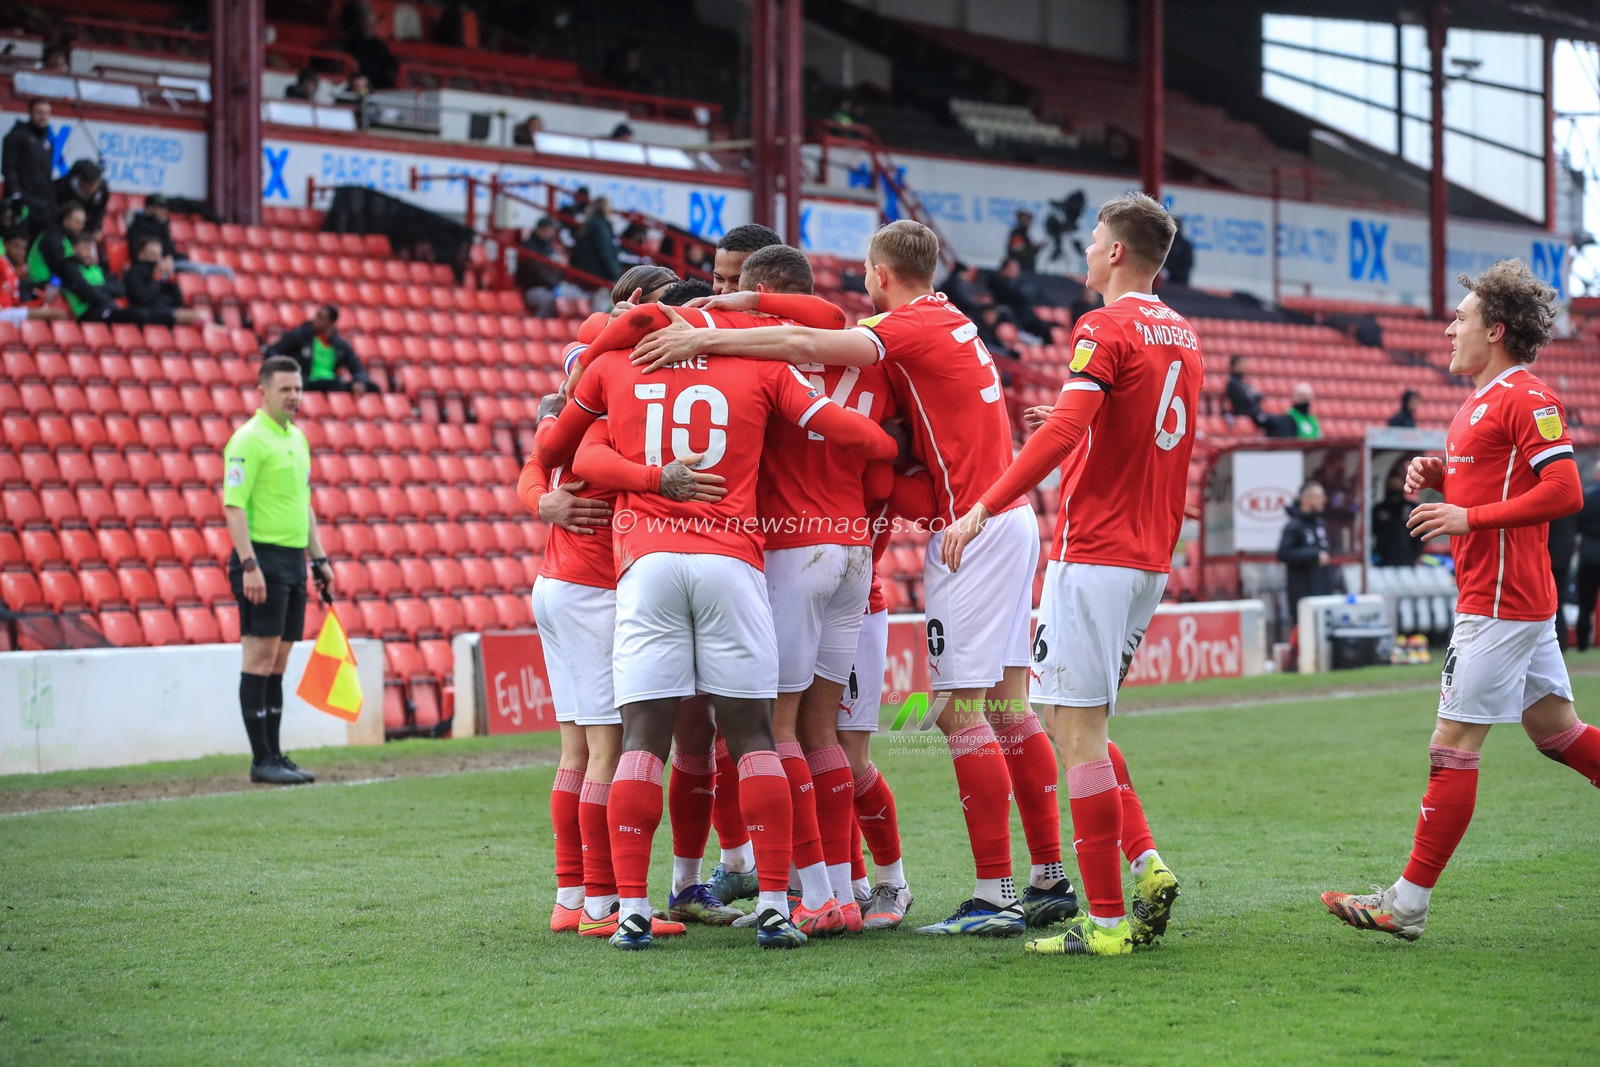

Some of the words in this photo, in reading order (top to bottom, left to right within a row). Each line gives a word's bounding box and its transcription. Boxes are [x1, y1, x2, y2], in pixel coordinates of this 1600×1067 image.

[98, 132, 183, 163] DELIVERED
[322, 153, 406, 191] PARCEL
[689, 191, 726, 237] DX
[1350, 220, 1389, 283] DX
[634, 383, 729, 470] 10
[1154, 360, 1188, 451] 6
[1033, 624, 1048, 663] 6
[1177, 616, 1241, 683] Brew
[494, 671, 523, 726] Ey
[832, 781, 852, 794] BFC
[619, 825, 641, 835] BFC
